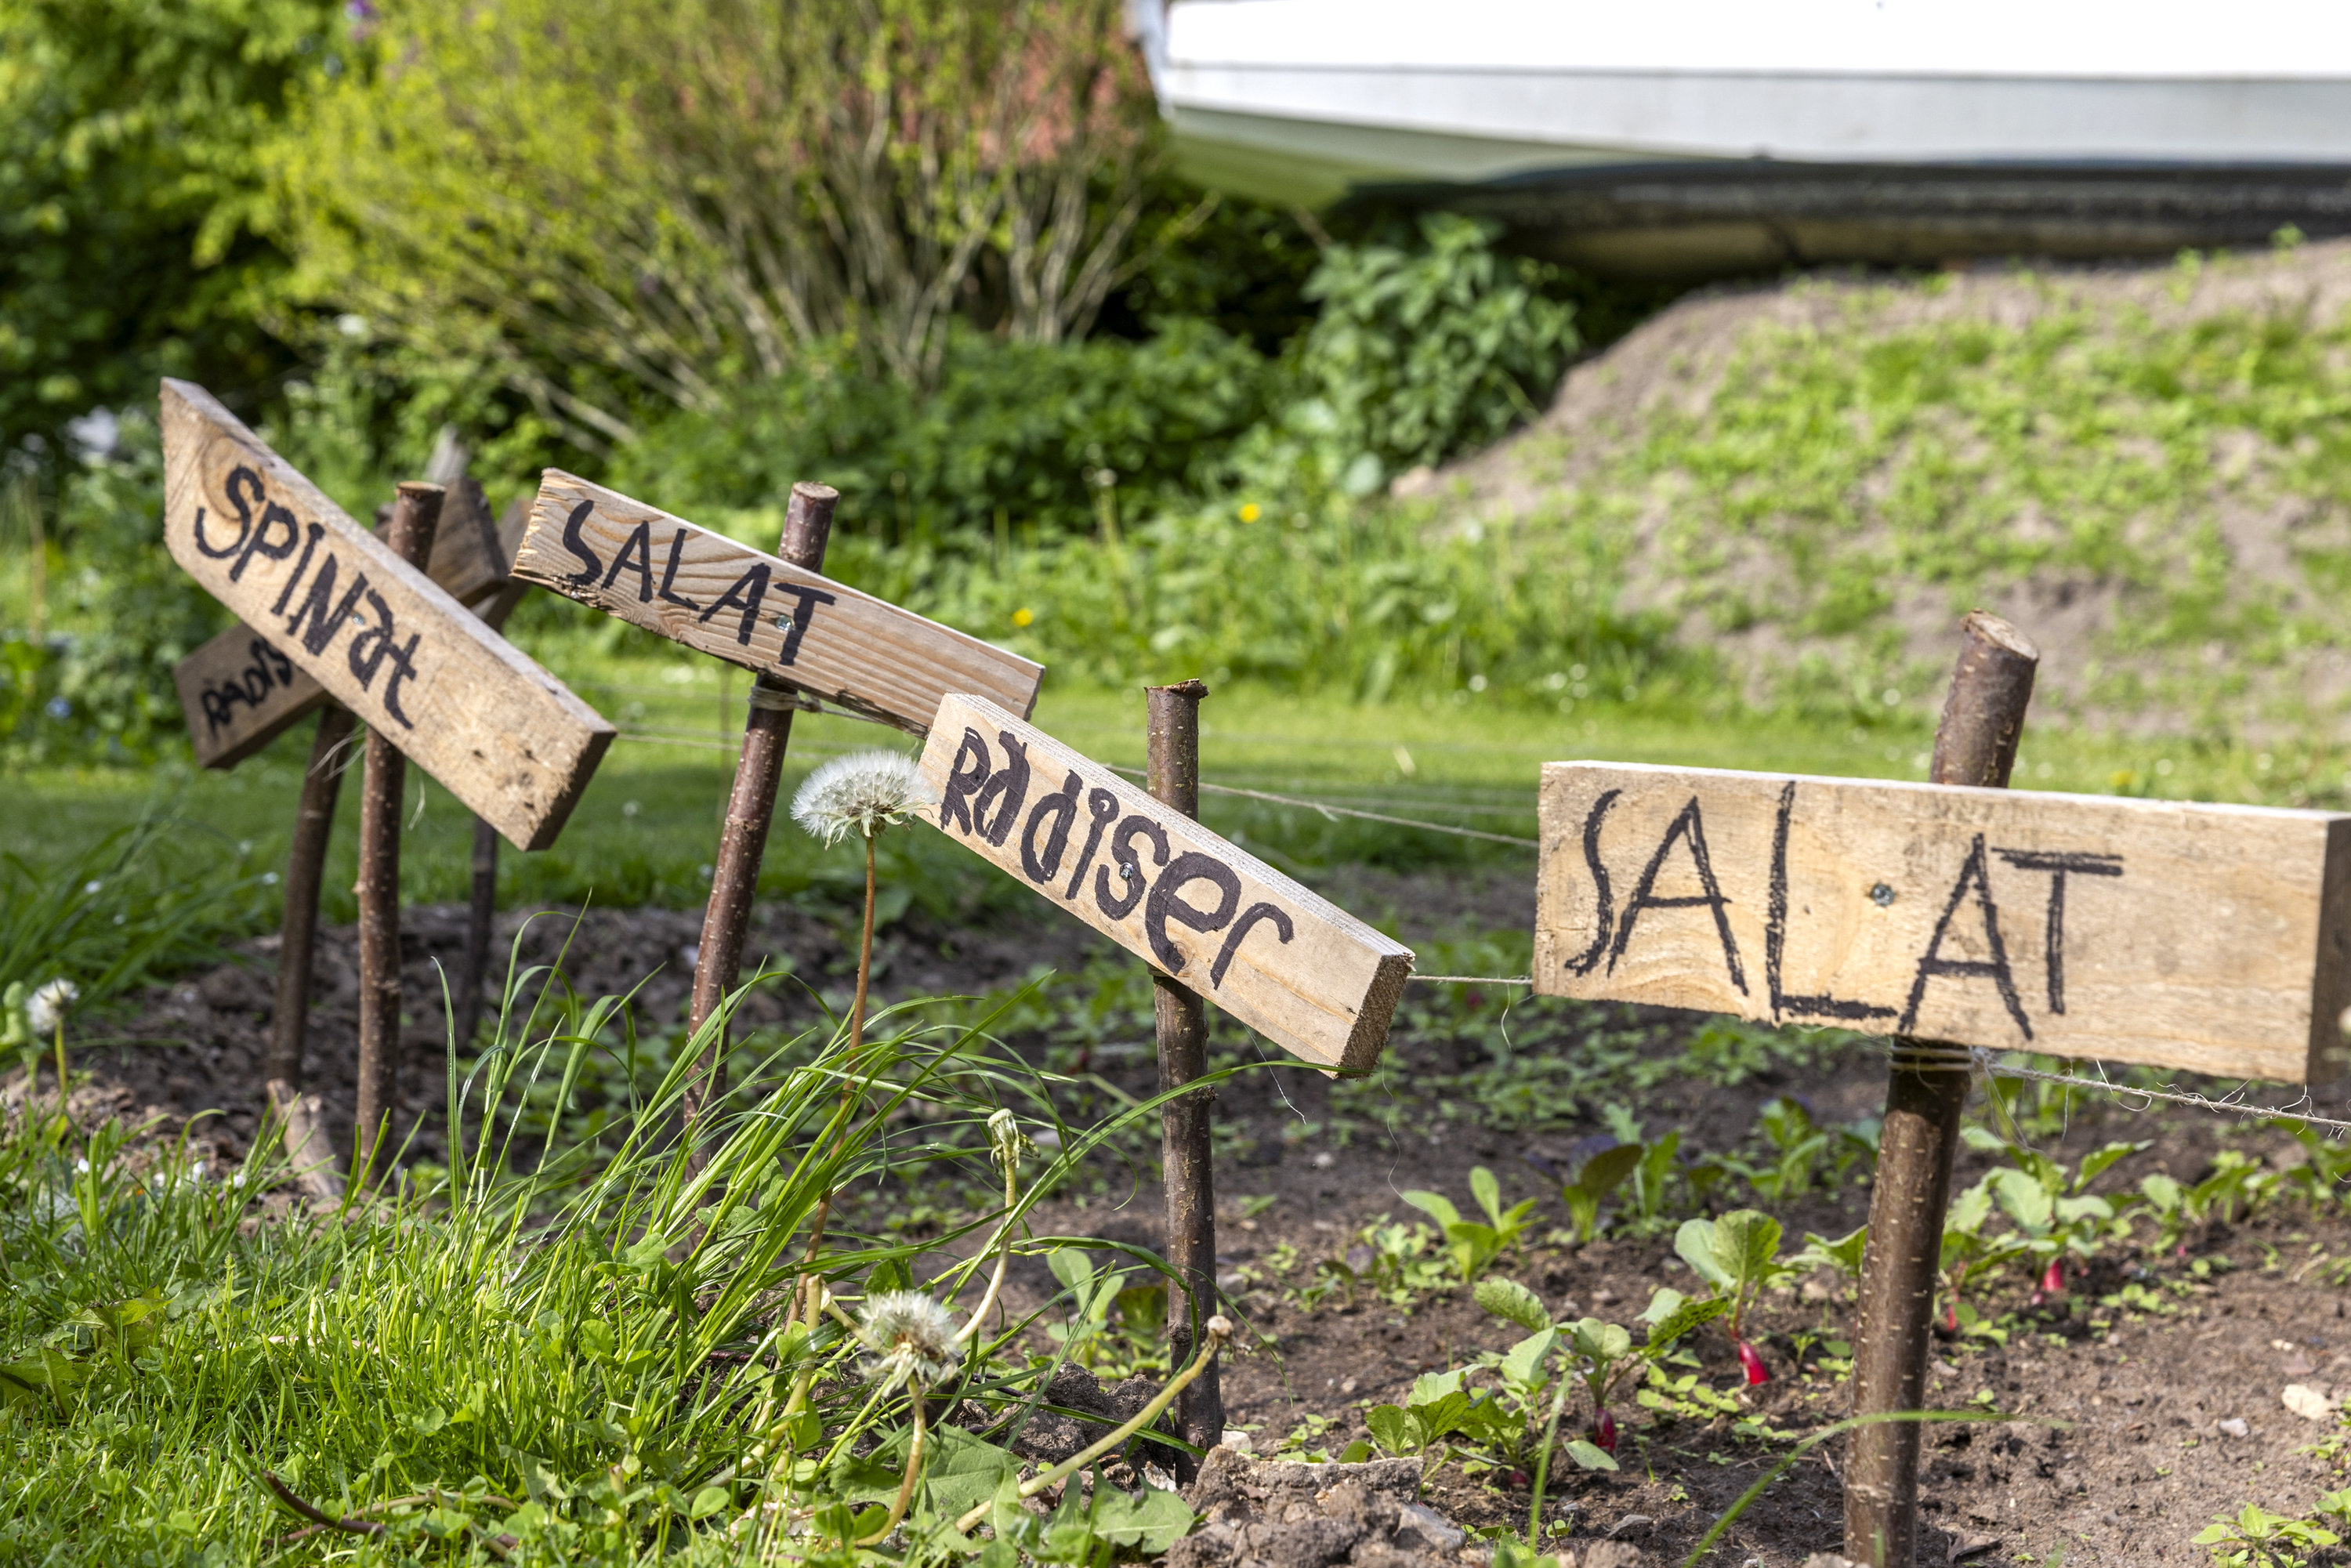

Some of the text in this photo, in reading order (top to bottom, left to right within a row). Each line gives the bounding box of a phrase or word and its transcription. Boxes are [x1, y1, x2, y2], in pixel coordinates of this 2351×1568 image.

[561, 498, 837, 666] SALAT
[940, 726, 1295, 990] Radiser
[1565, 780, 2124, 1041] SALAT
